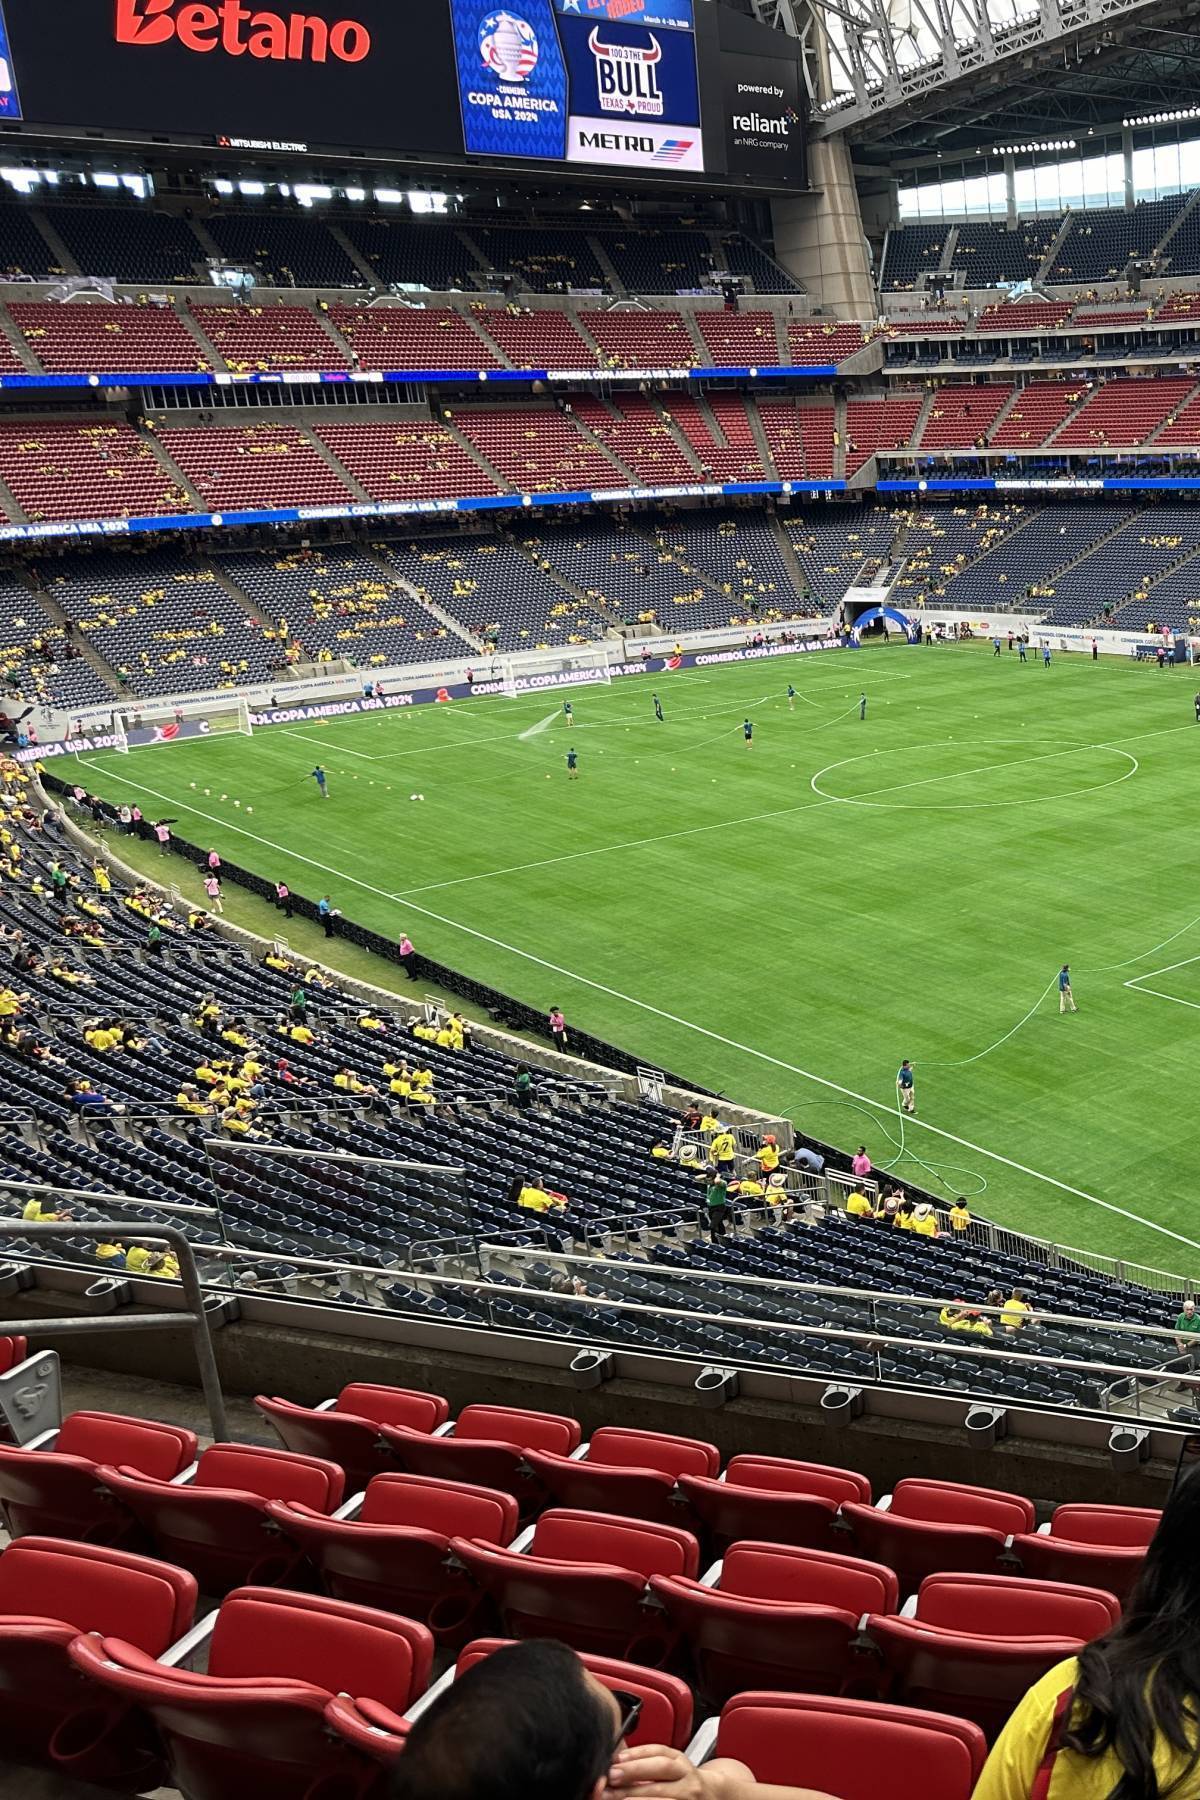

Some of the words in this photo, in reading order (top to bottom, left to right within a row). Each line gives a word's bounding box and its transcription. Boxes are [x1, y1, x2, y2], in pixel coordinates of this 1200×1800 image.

[116, 0, 371, 62] Betano
[610, 48, 629, 59] 100.3
[629, 51, 641, 60] THE
[600, 59, 660, 99] BULL
[737, 83, 773, 95] powered
[773, 86, 785, 98] by
[468, 92, 502, 107] COPA
[503, 95, 559, 112] AMERICA
[602, 97, 624, 109] TEXAS
[637, 101, 661, 113] PROUD
[492, 109, 513, 120] USA
[514, 111, 539, 122] 2024
[732, 112, 789, 135] reliant
[229, 138, 272, 150] MITSUBISHI
[272, 141, 308, 152] ELECTRIC
[579, 131, 655, 153] METRO
[734, 137, 742, 145] an
[743, 138, 758, 147] NRG
[759, 140, 789, 151] company
[298, 507, 350, 518] CONMEBOL
[351, 505, 377, 516] COPA
[377, 503, 418, 514] AMERICA
[418, 502, 436, 512] USA
[436, 501, 459, 510] 2024
[27, 524, 79, 536] AMERICA
[80, 522, 102, 533] USA
[102, 520, 129, 531] 2024
[696, 650, 745, 665] CONMEBOL
[745, 648, 767, 659] COPA
[766, 643, 806, 656] AMERICA
[807, 641, 822, 651] USA
[823, 638, 842, 648] 2024
[530, 675, 557, 687] COPA
[558, 669, 602, 684] AMERICA
[603, 665, 623, 677] USA
[623, 662, 648, 674] 2024
[272, 706, 307, 724] COPA
[306, 700, 360, 718] AMERICA
[360, 697, 384, 711] USA
[384, 693, 413, 707] 2024
[16, 743, 65, 763] MERICA
[64, 739, 94, 753] USA
[721, 1141, 729, 1151] 7
